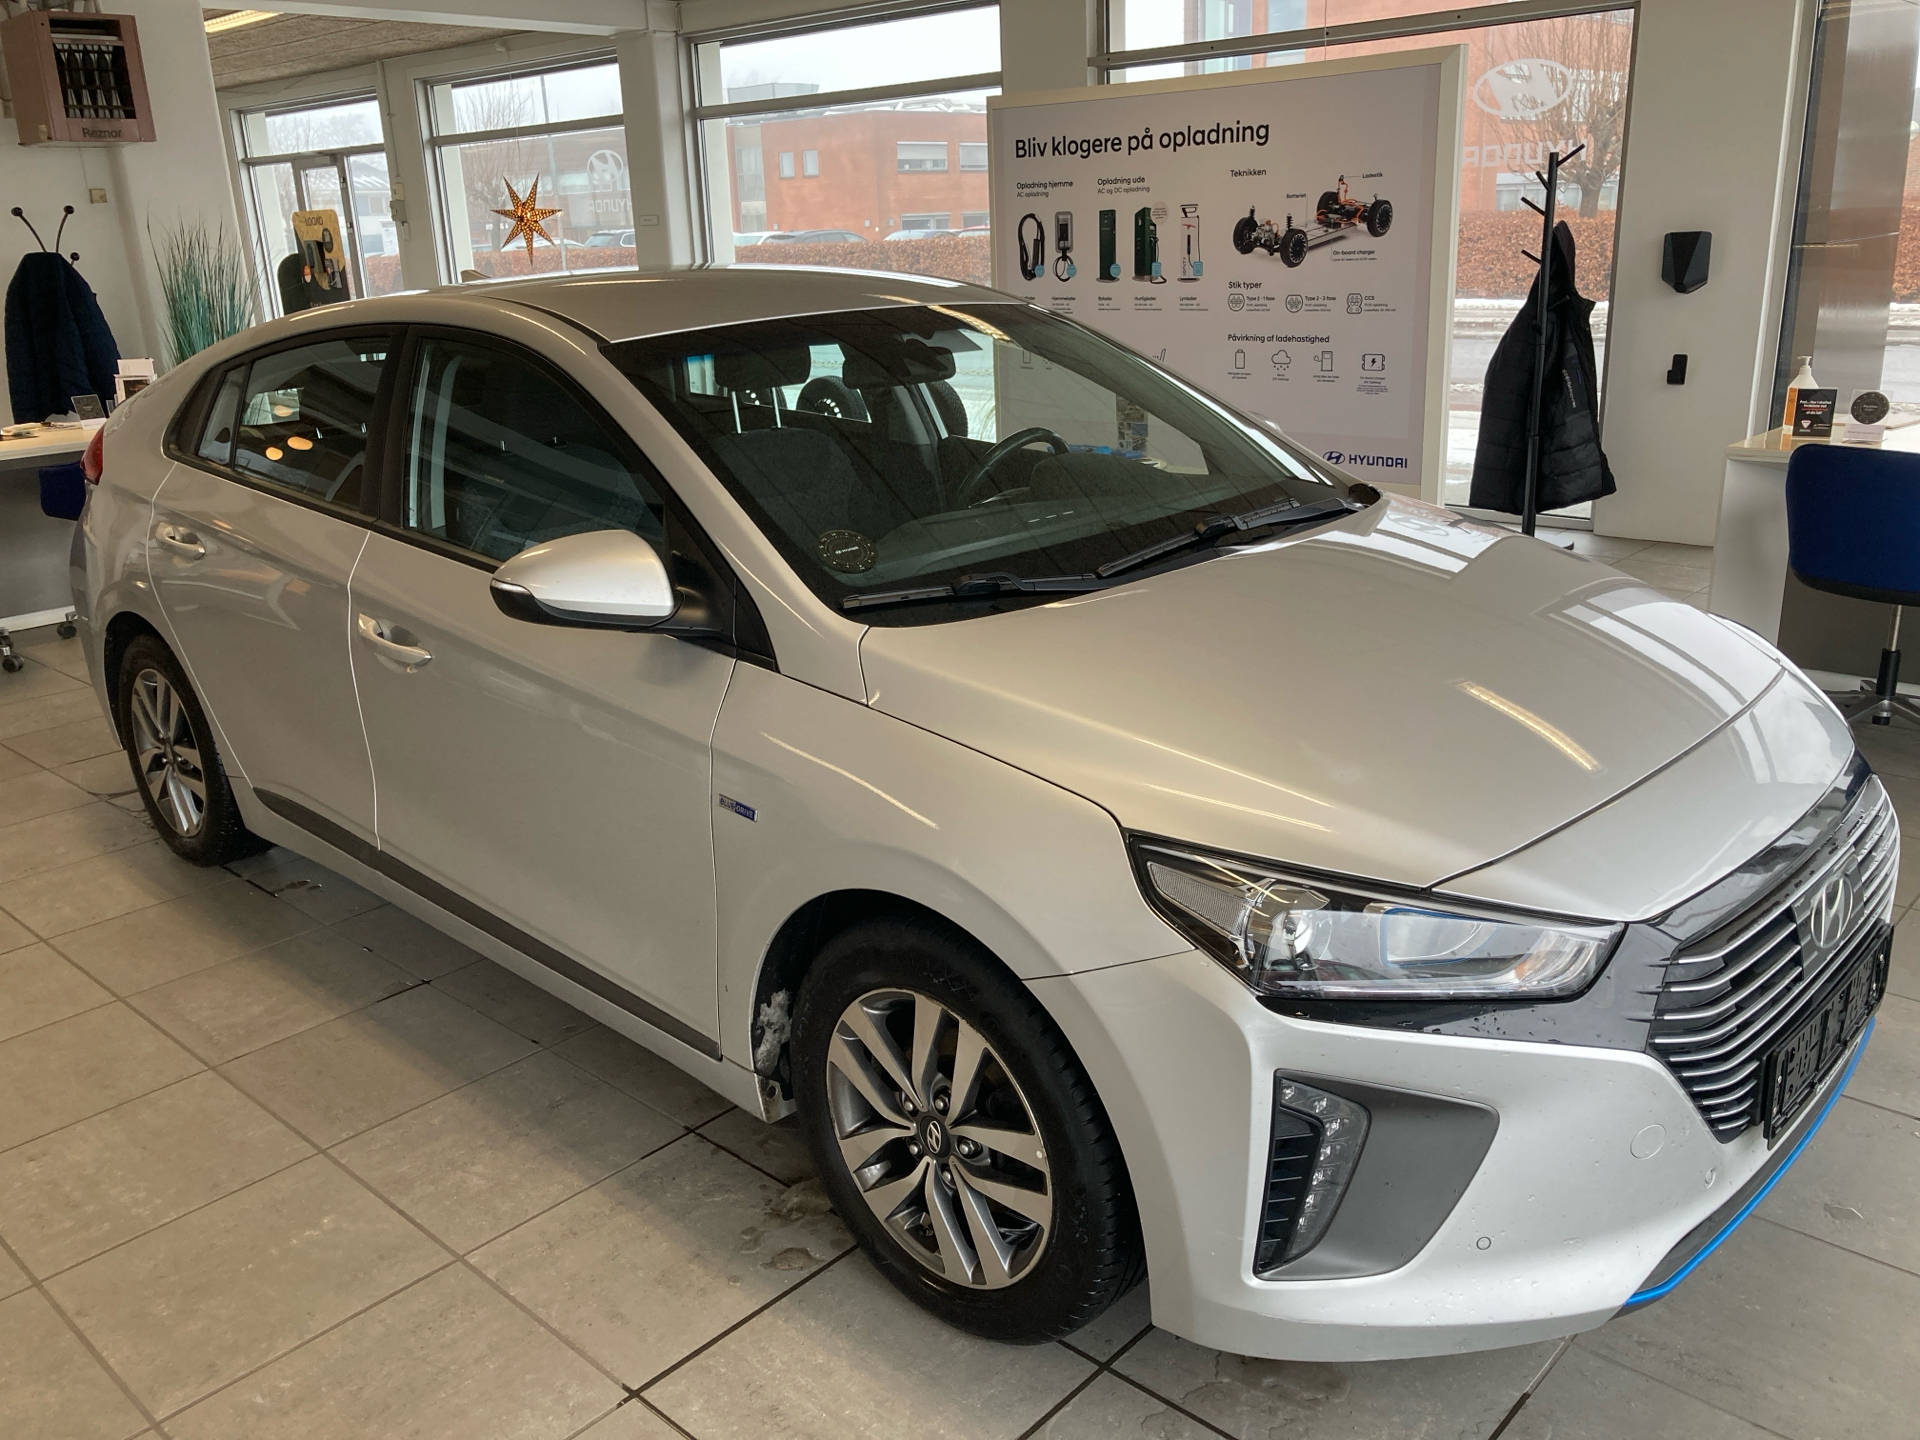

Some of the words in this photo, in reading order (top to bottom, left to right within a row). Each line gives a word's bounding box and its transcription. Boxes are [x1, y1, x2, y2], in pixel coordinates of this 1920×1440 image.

[82, 128, 122, 138] Reznor
[1015, 138, 1047, 158] Bliv
[1052, 135, 1122, 159] klogere
[1128, 127, 1153, 155] på
[1159, 120, 1270, 152] opladning
[1230, 168, 1267, 178] Teknikken
[1016, 181, 1048, 190] Opladning
[1049, 181, 1073, 189] hjemme
[1097, 177, 1131, 186] Opladning
[1132, 176, 1146, 184] ude
[1025, 190, 1049, 198] opladning
[1123, 186, 1150, 194] opladning
[1228, 281, 1241, 289] Stik
[1243, 281, 1262, 290] typer
[1227, 333, 1265, 343] Påvirkning
[1275, 335, 1330, 344] ladehastighed
[1348, 454, 1408, 469] HYUNDAI
